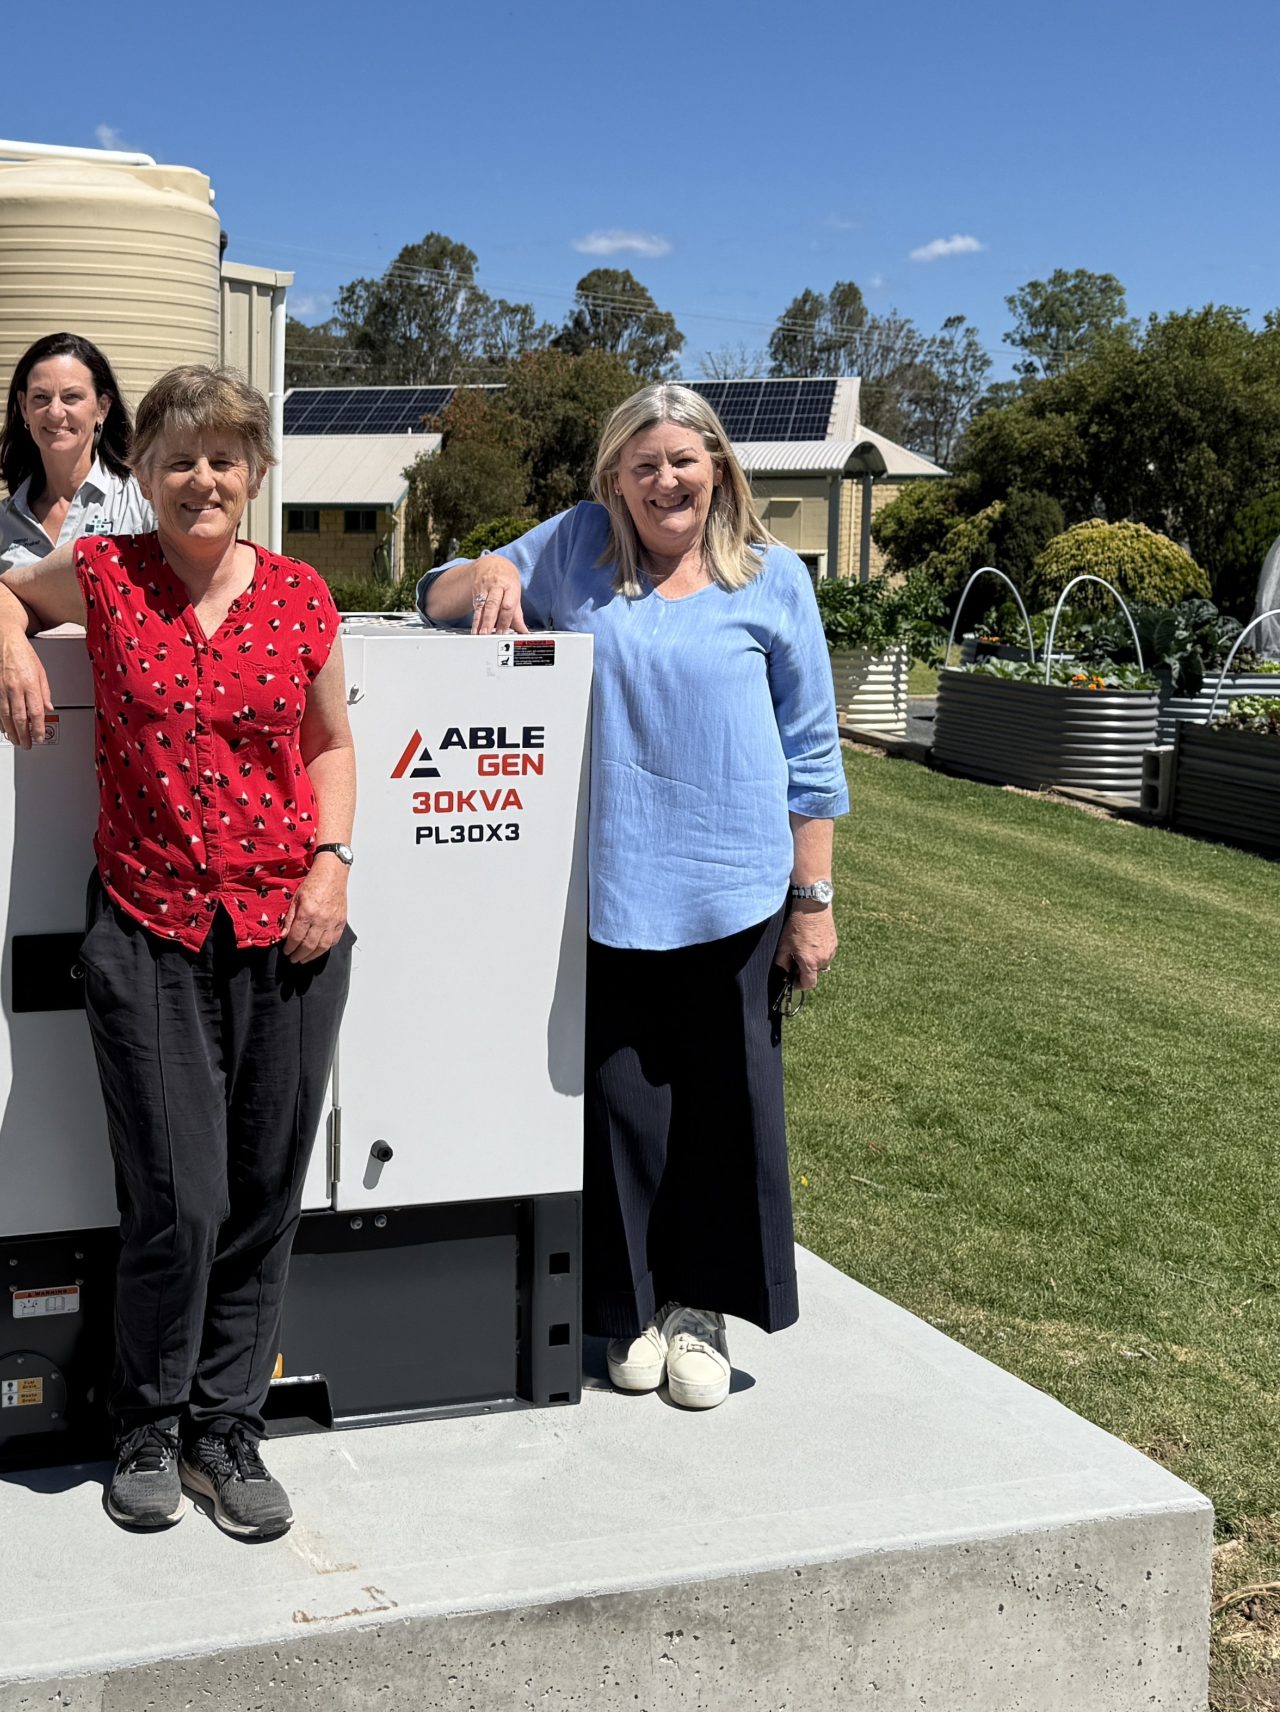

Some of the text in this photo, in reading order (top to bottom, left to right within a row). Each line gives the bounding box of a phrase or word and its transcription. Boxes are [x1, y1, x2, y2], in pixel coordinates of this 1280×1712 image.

[439, 726, 545, 749] ABLE
[478, 754, 544, 776] GEN
[412, 788, 523, 814] 30KVA
[415, 823, 520, 845] PL30X3
